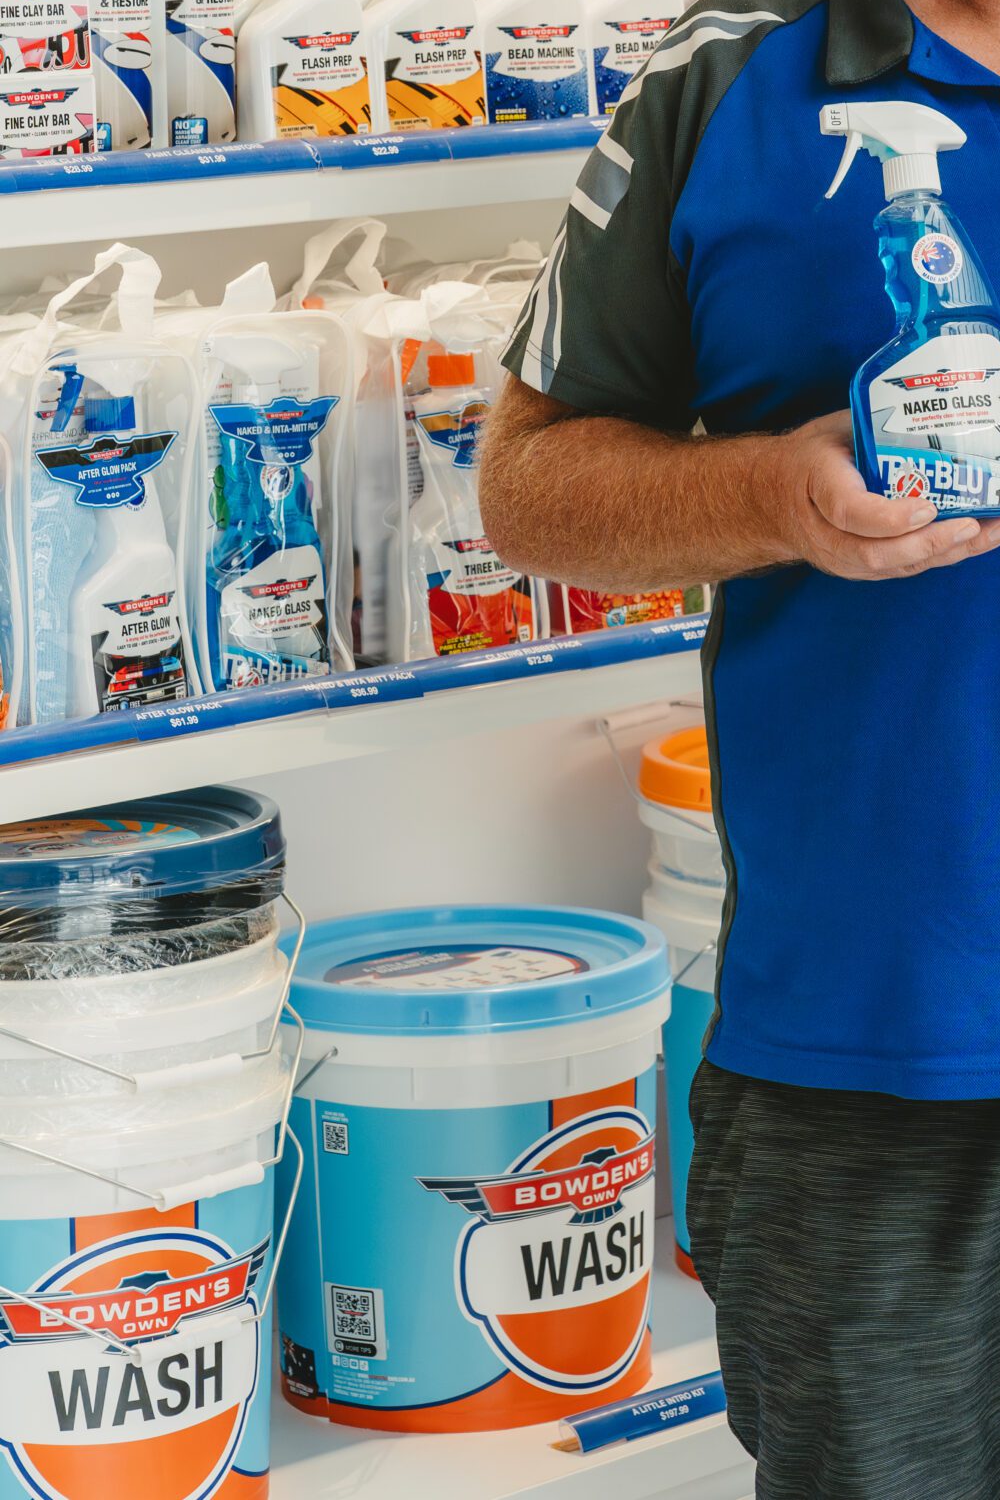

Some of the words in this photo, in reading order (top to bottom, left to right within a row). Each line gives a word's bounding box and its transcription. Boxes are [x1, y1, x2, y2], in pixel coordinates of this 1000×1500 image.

[1, 5, 20, 19] FINE
[22, 4, 47, 18] CLAY
[49, 3, 64, 16] BAR
[420, 30, 461, 40] BOWDEN'S
[521, 27, 564, 37] BOWDEN'S
[306, 36, 347, 45] BOWDEN'S
[615, 42, 641, 54] BEAD
[415, 51, 444, 64] FLASH
[447, 49, 467, 61] PREP
[508, 48, 535, 59] BEAD
[537, 46, 575, 58] MACHINE
[302, 56, 331, 70] FLASH
[333, 55, 353, 68] PREP
[14, 93, 59, 102] BOWDEN'S
[4, 117, 25, 130] FINE
[27, 115, 49, 129] CLAY
[52, 113, 70, 126] BAR
[175, 120, 188, 130] NO
[372, 146, 399, 156] $22.99
[198, 154, 226, 164] $31.99
[913, 372, 976, 386] BOWDEN'S
[903, 398, 948, 415] NAKED
[952, 394, 992, 409] GLASS
[237, 425, 262, 436] NAKED
[264, 425, 270, 434] &
[272, 423, 307, 434] INTA-MITT
[78, 468, 100, 481] AFTER
[101, 464, 120, 475] GLOW
[120, 461, 137, 473] PACK
[464, 560, 493, 576] THREE
[259, 581, 303, 594] BOWDEN'S
[126, 597, 164, 610] BOWDEN'S
[249, 604, 282, 621] NAKED
[284, 599, 311, 615] GLASS
[121, 621, 149, 637] AFTER
[151, 616, 171, 630] GLOW
[527, 654, 553, 667] $72.99
[350, 686, 378, 698] $36.99
[107, 703, 119, 711] SPOT
[130, 700, 141, 709] FREE
[136, 710, 165, 721] AFTER
[166, 705, 195, 717] GLOW
[196, 701, 222, 712] PACK
[170, 715, 199, 728] $61.99
[515, 1152, 649, 1205] BOWDEN'S
[582, 1188, 615, 1206] OWN
[520, 1210, 644, 1301] WASH
[39, 1277, 230, 1328] BOWDEN'S
[122, 1316, 169, 1334] OWN
[47, 1340, 223, 1432] WASH
[632, 1408, 639, 1417] A
[639, 1399, 667, 1414] LITTLE
[668, 1392, 692, 1406] INTRO
[691, 1387, 706, 1398] KIT
[660, 1404, 690, 1421] $197.99
